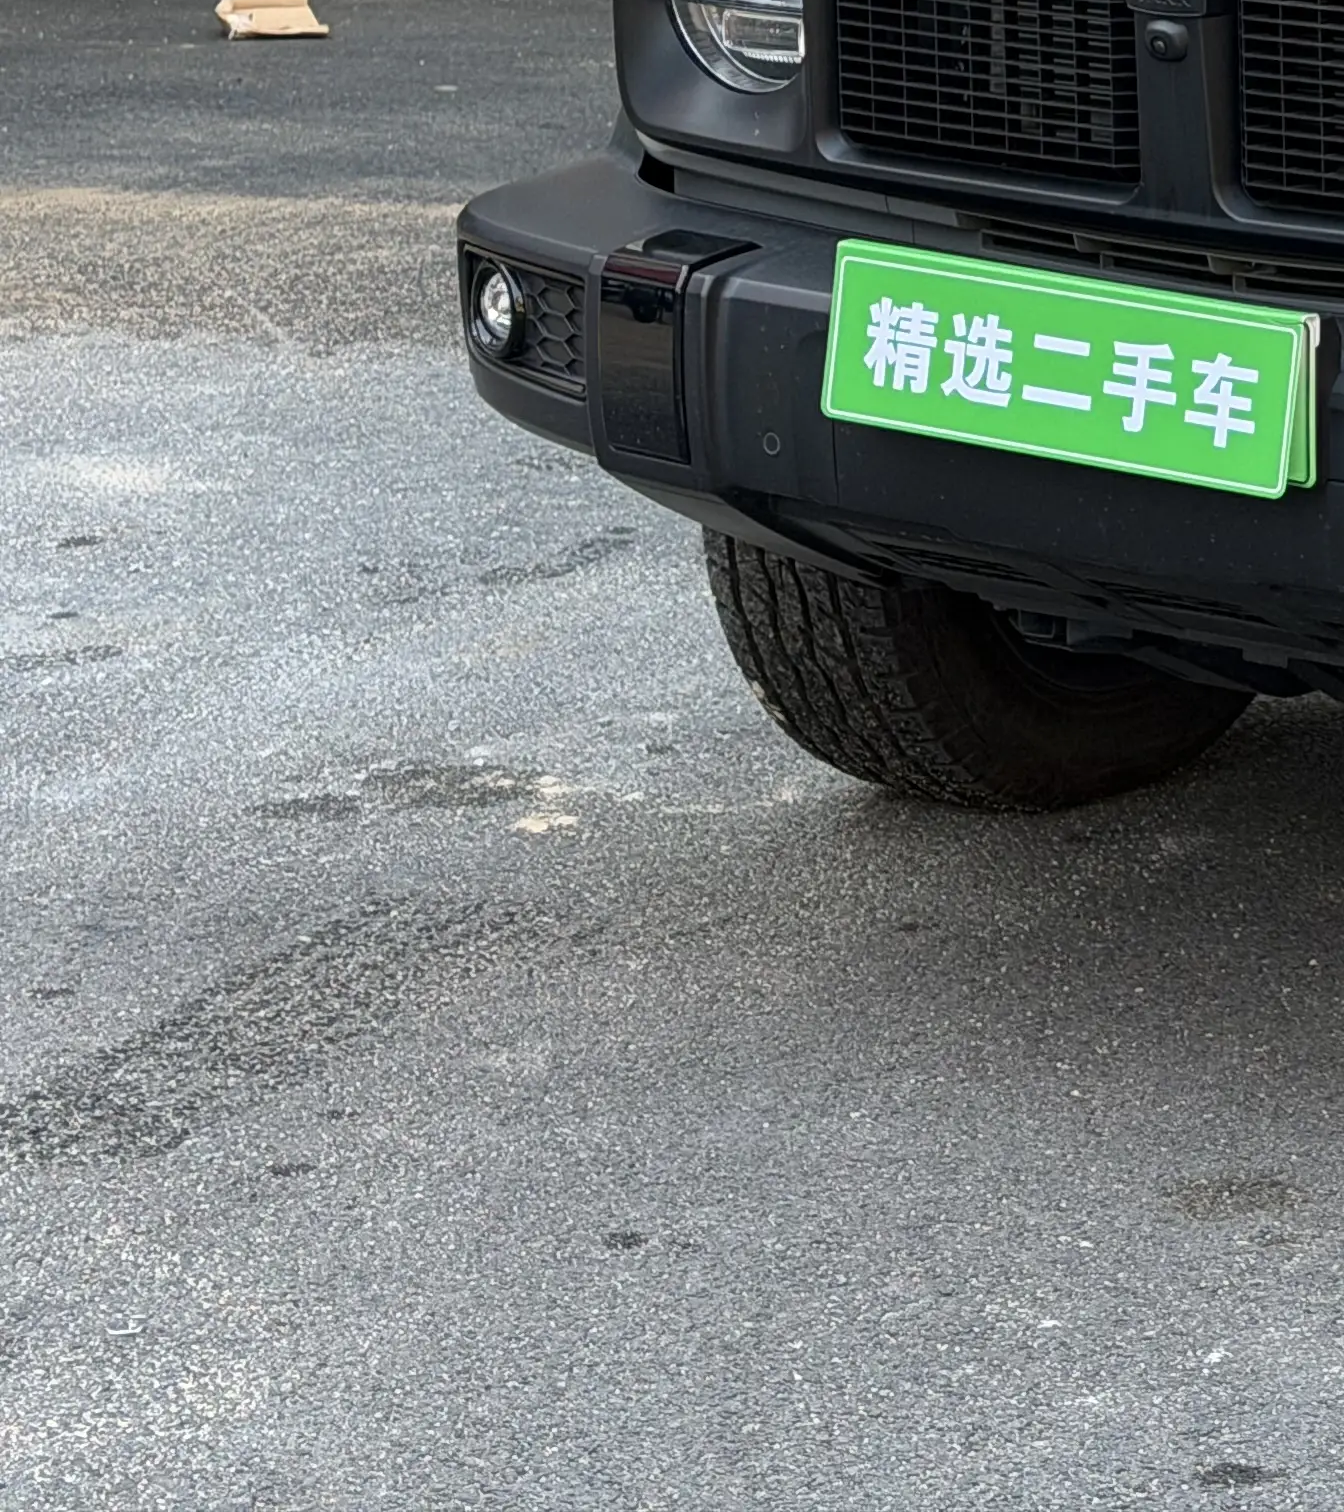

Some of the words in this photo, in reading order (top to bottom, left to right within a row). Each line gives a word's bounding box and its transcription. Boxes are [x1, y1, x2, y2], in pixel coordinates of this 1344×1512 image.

[864, 297, 1259, 449] 精选二手车
